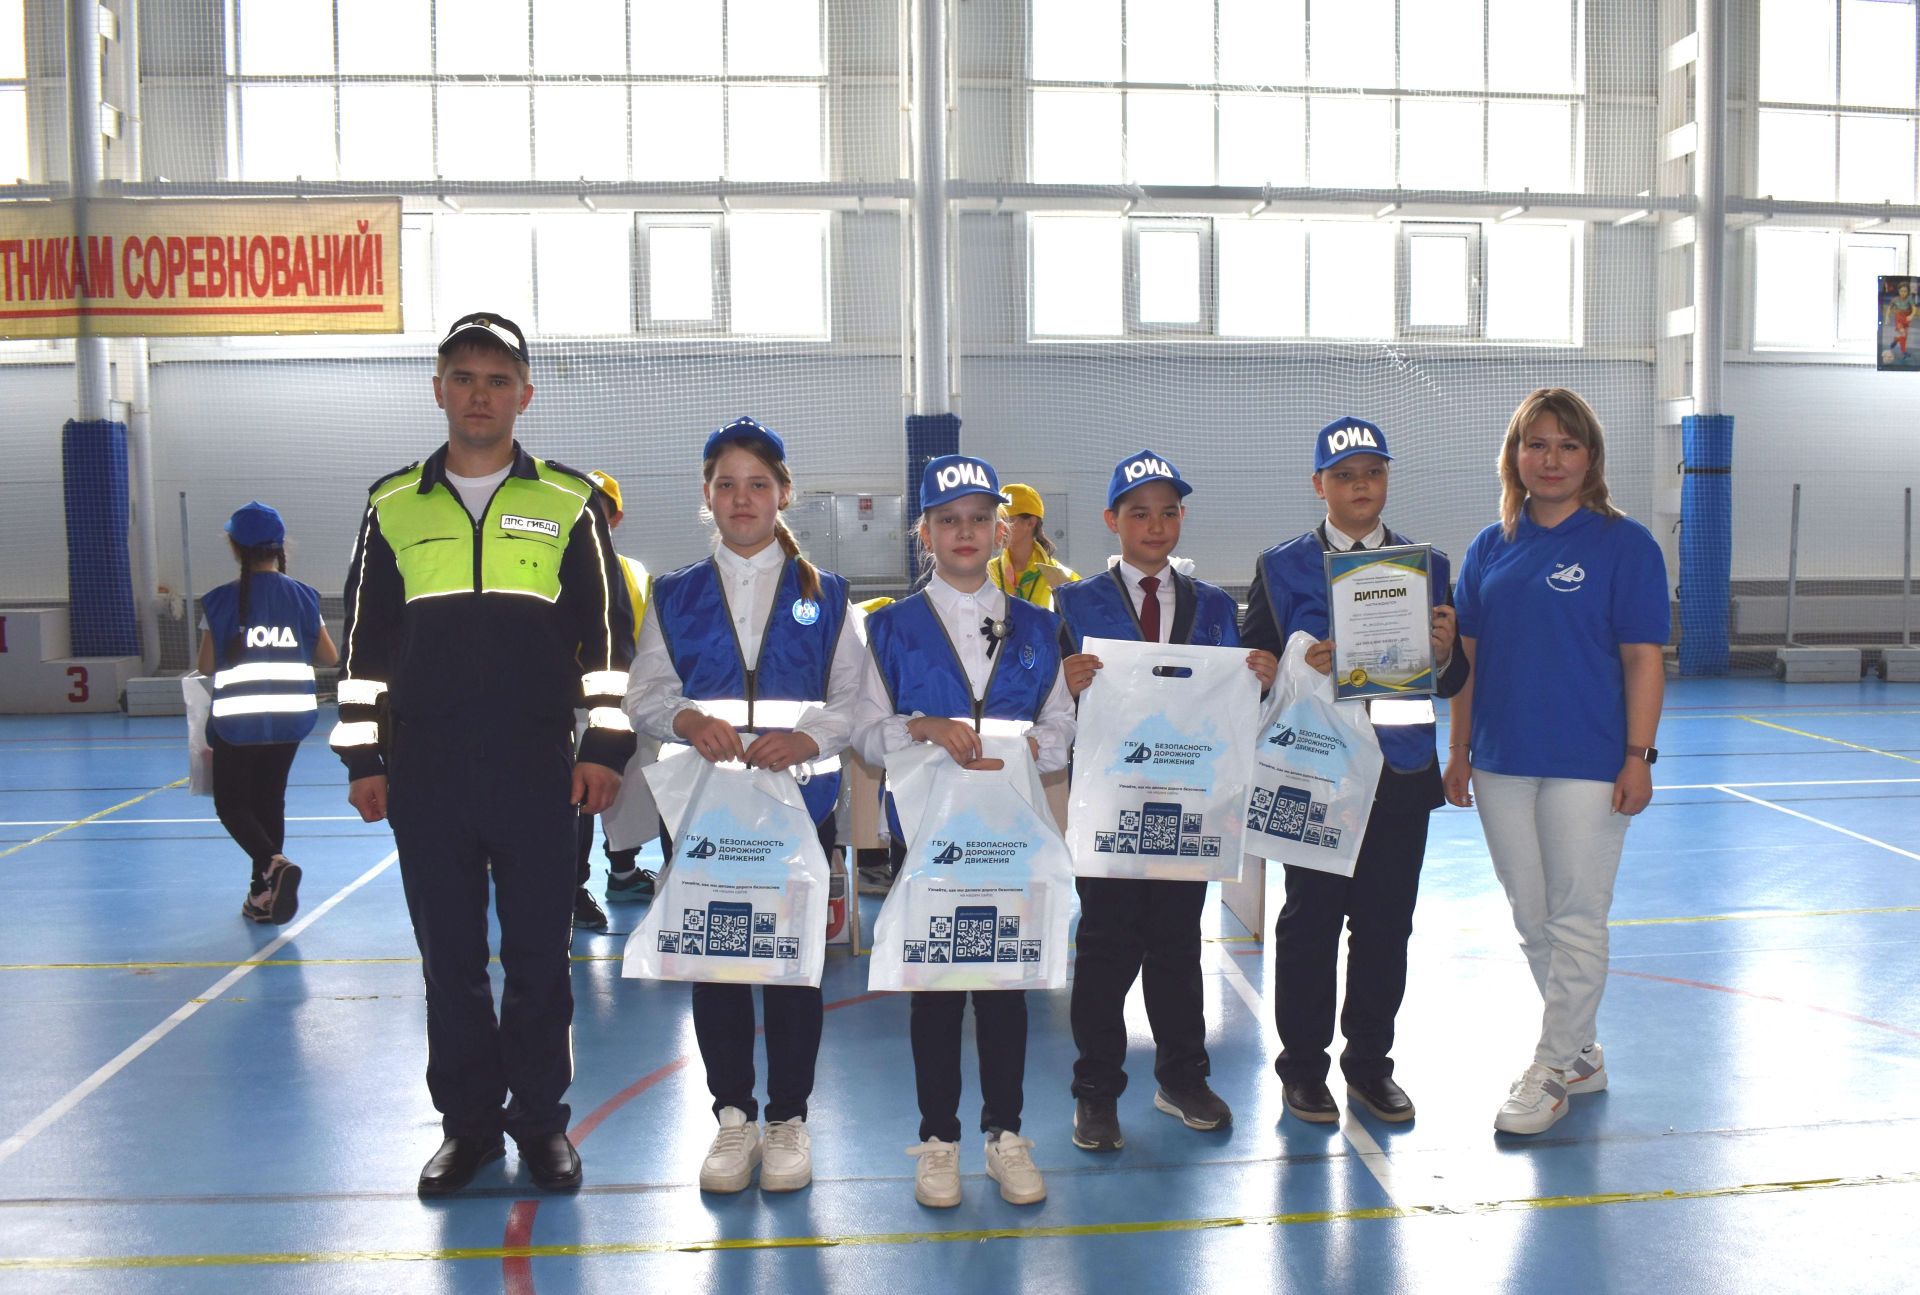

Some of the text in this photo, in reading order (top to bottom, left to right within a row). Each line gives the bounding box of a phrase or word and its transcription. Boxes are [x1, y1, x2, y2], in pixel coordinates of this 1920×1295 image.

[0, 220, 384, 301] ТНИКАМ СОРЕВНОВАНИЙ!
[1327, 426, 1378, 454] ЮИД
[936, 463, 991, 492] ЮИД
[1124, 458, 1174, 483] ЮИД
[503, 517, 557, 534] ДПС ГИБДД
[1354, 587, 1407, 602] ДИПЛОМ
[246, 625, 298, 648] ЮИД
[66, 666, 89, 703] 3
[1273, 721, 1287, 730] ГБУ
[1297, 736, 1336, 750] ДОРОЖНОГО
[1298, 729, 1347, 749] БЕЗОПАСНОСТЬ
[1153, 750, 1201, 759] ДОРОЖНОГО
[1154, 743, 1213, 752] БЕЗОПАСНОСТЬ
[1295, 743, 1329, 756] ДВИЖЕНИЯ
[719, 838, 784, 847] БЕЗОПАСНОСТЬ
[718, 846, 772, 854] ДОРОЖНОГО
[965, 849, 1016, 857] ДОРОЖНОГО
[718, 854, 765, 862] ДВИЖЕНИЯ
